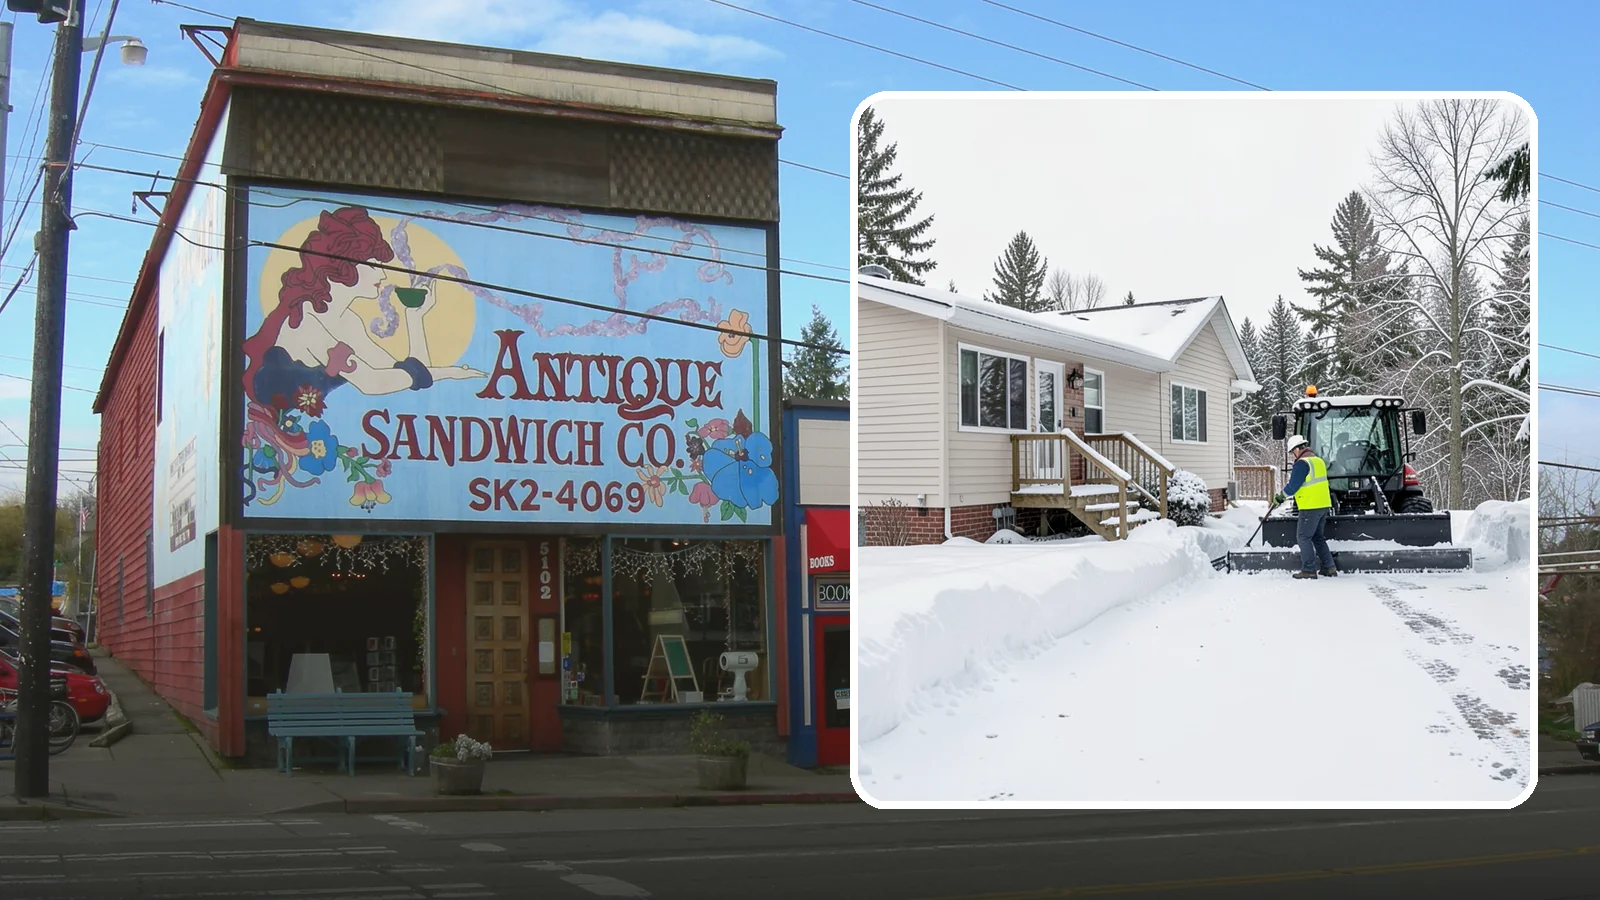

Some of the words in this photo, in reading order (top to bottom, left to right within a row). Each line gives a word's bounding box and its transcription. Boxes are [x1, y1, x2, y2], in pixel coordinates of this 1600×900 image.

[476, 329, 724, 422] ANTIQUE
[360, 409, 605, 467] SANDWICH
[616, 422, 685, 469] CO.
[469, 477, 646, 512] SK2-4069
[540, 541, 552, 599] 5102
[809, 555, 835, 569] BOOKS
